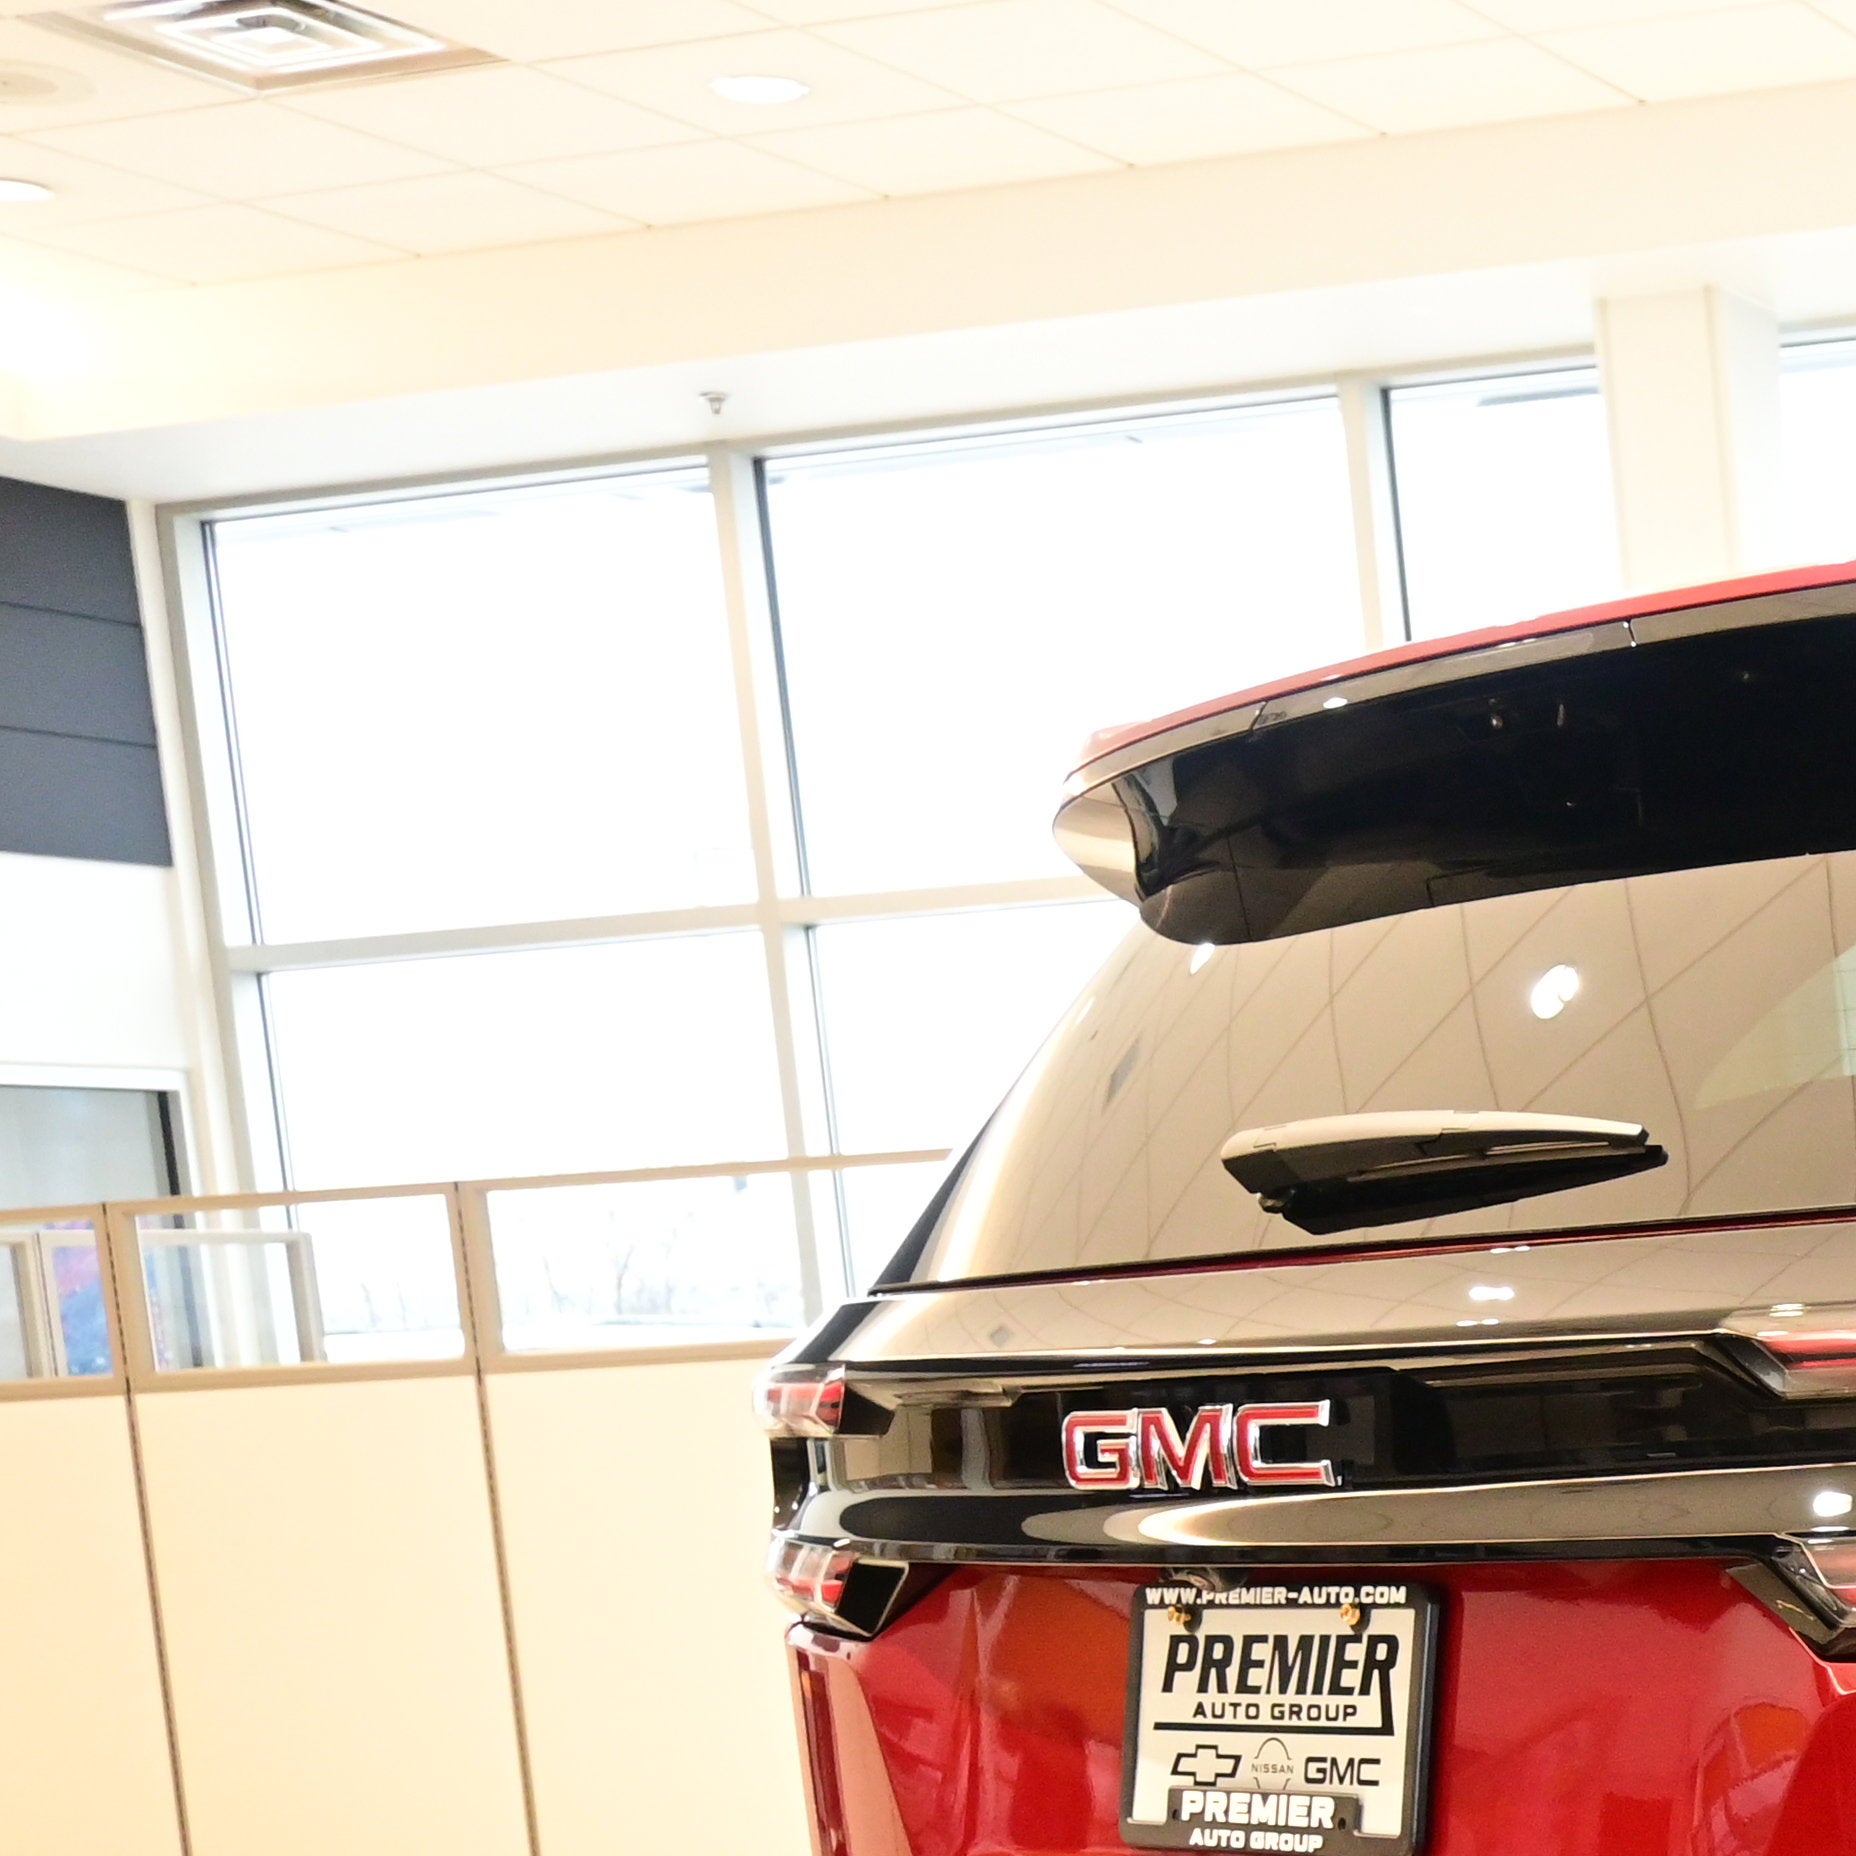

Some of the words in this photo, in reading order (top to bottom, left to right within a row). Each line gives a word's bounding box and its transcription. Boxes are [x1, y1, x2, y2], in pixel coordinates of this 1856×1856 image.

[1062, 1399, 1336, 1491] GMC
[1161, 1634, 1399, 1697] PREMIER
[1193, 1701, 1260, 1720] AUTO
[1270, 1703, 1358, 1722] GROUP
[1251, 1762, 1294, 1775] NISSAN
[1304, 1756, 1381, 1787] GMC
[1181, 1790, 1335, 1829] PREMIER
[1189, 1828, 1246, 1848] AUTO
[1250, 1831, 1323, 1853] GROUP
